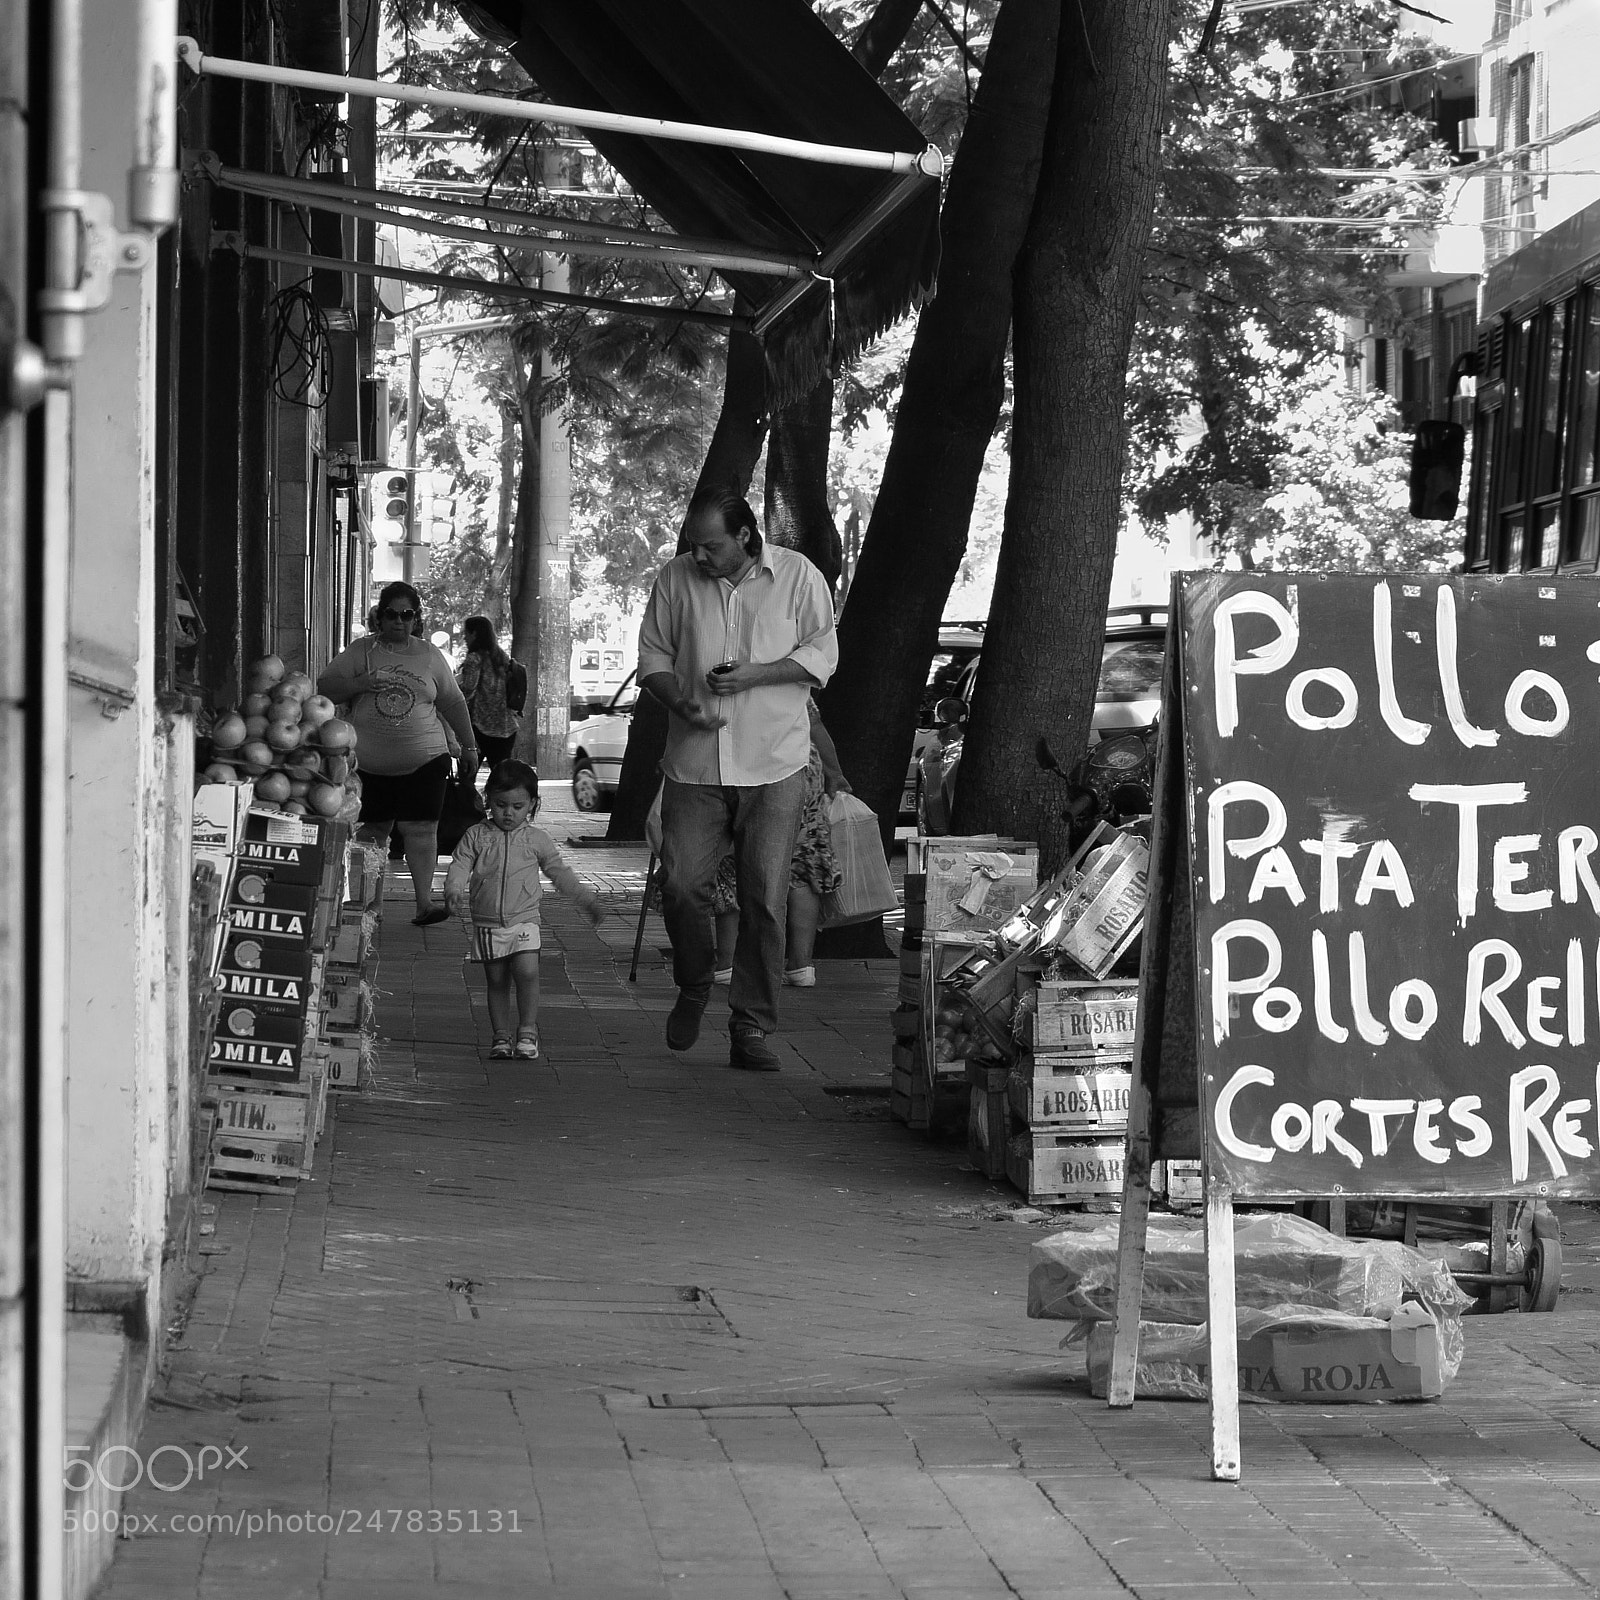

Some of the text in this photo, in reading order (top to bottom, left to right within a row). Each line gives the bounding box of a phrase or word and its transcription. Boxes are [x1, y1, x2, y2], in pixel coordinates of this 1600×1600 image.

[1213, 579, 1570, 748] Pollo
[241, 843, 299, 862] MILA
[1208, 781, 1415, 914] PATA
[1211, 919, 1439, 1048] Pollo
[1054, 1088, 1131, 1114] ROSARIO
[1214, 1063, 1600, 1184] CORTES RE
[1061, 1159, 1125, 1184] ROSAR
[1302, 1363, 1394, 1392] ROJA
